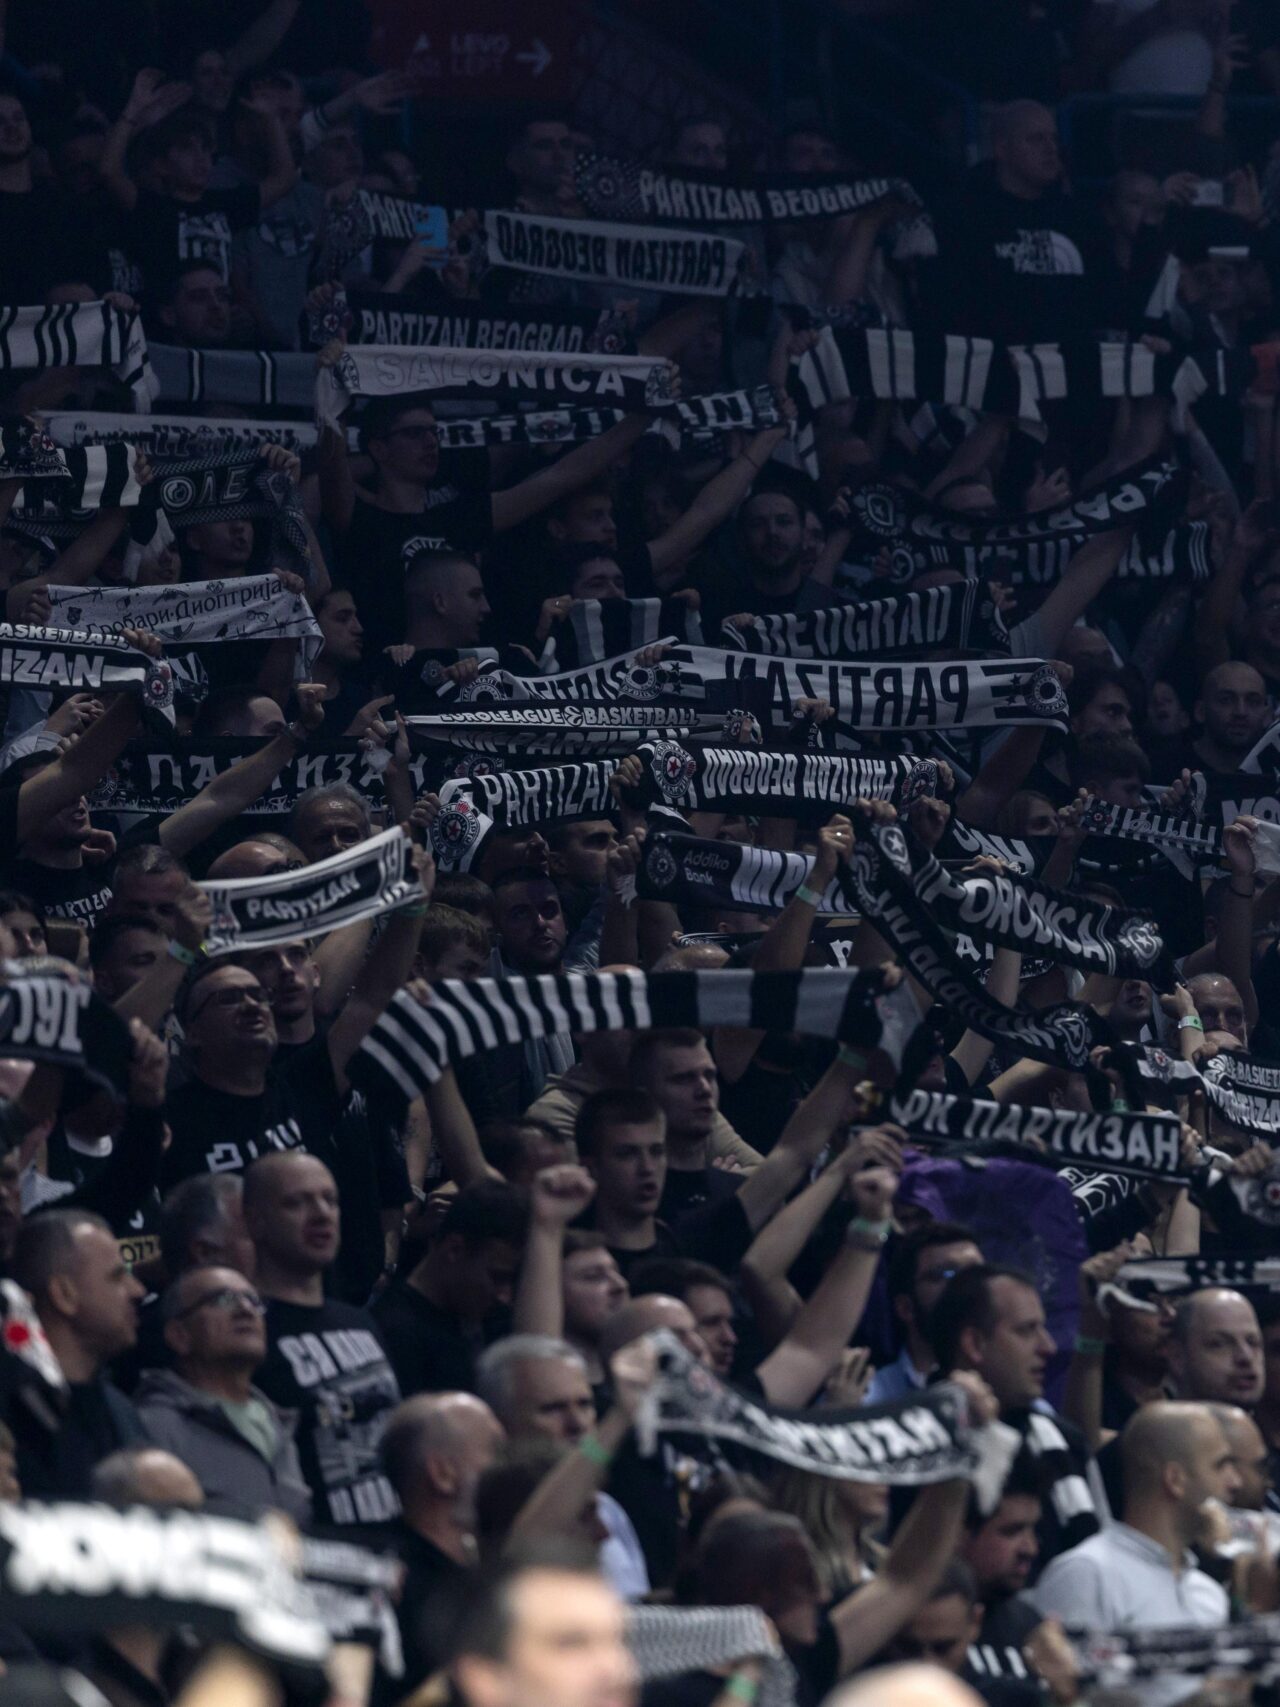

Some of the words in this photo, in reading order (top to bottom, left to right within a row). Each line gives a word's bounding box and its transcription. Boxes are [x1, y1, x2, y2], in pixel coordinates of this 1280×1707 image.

[640, 170, 763, 220] PARTIZAN
[361, 309, 470, 348] PARTIZAN
[474, 319, 584, 352] BEOGRAD
[373, 353, 626, 398] SALONICA
[175, 579, 283, 620] Диоптрија
[440, 707, 564, 725] EUROLEAGUE
[583, 706, 700, 726] BASKETBALL
[683, 850, 731, 872] Addiko
[684, 865, 715, 887] Bank
[246, 869, 362, 920] PARTIZAN
